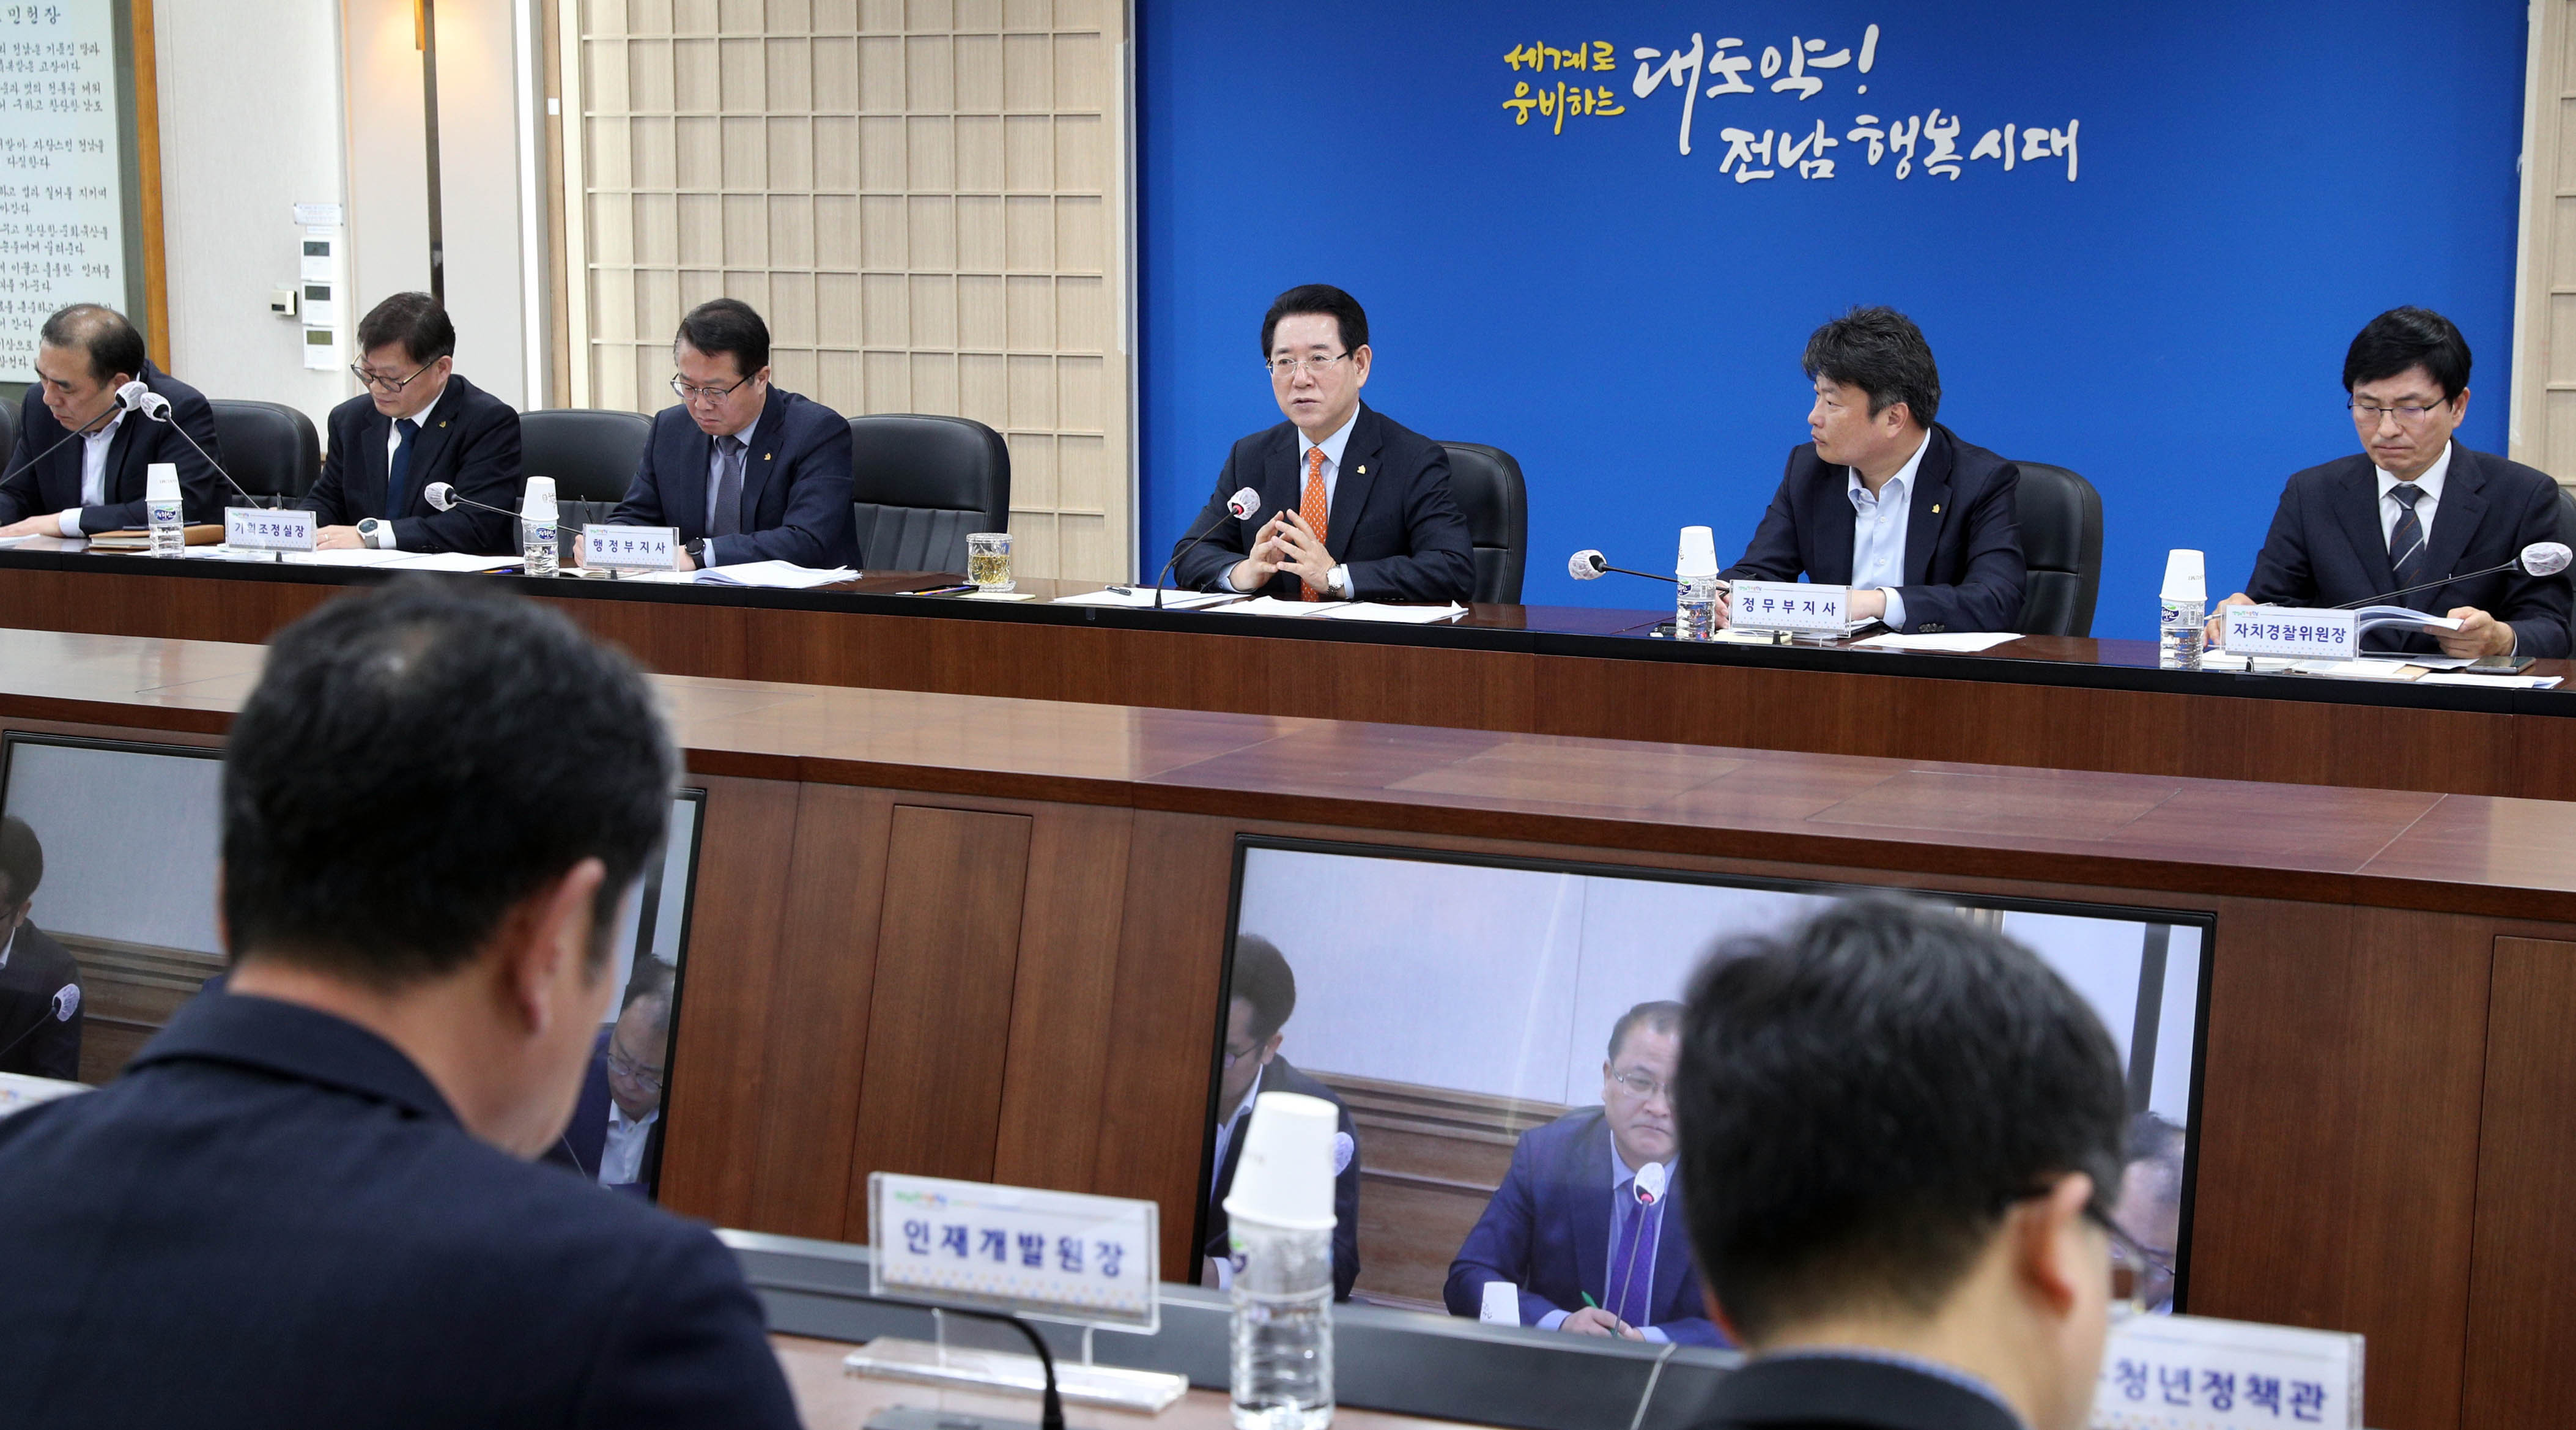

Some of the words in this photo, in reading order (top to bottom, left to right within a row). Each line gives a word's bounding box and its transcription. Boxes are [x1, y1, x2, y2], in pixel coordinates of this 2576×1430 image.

[13, 42, 40, 56] 전남은
[1503, 41, 1615, 72] 세계로
[39, 59, 81, 73] 고장이다
[1632, 24, 1879, 155] 대도약!
[1503, 81, 1625, 135] 웅비하는
[1720, 119, 1838, 183] 전남
[1846, 108, 2079, 182] 행복시대
[7, 154, 51, 170] 다짐한다
[235, 522, 305, 539] 기획조정실장
[593, 538, 666, 555] 행정부지사
[1742, 598, 1837, 617] 정무부지사
[2234, 623, 2347, 644] 자치경찰위원장
[903, 1219, 1125, 1278] 인재개발원장
[2099, 1358, 2329, 1423] 청년정책관
